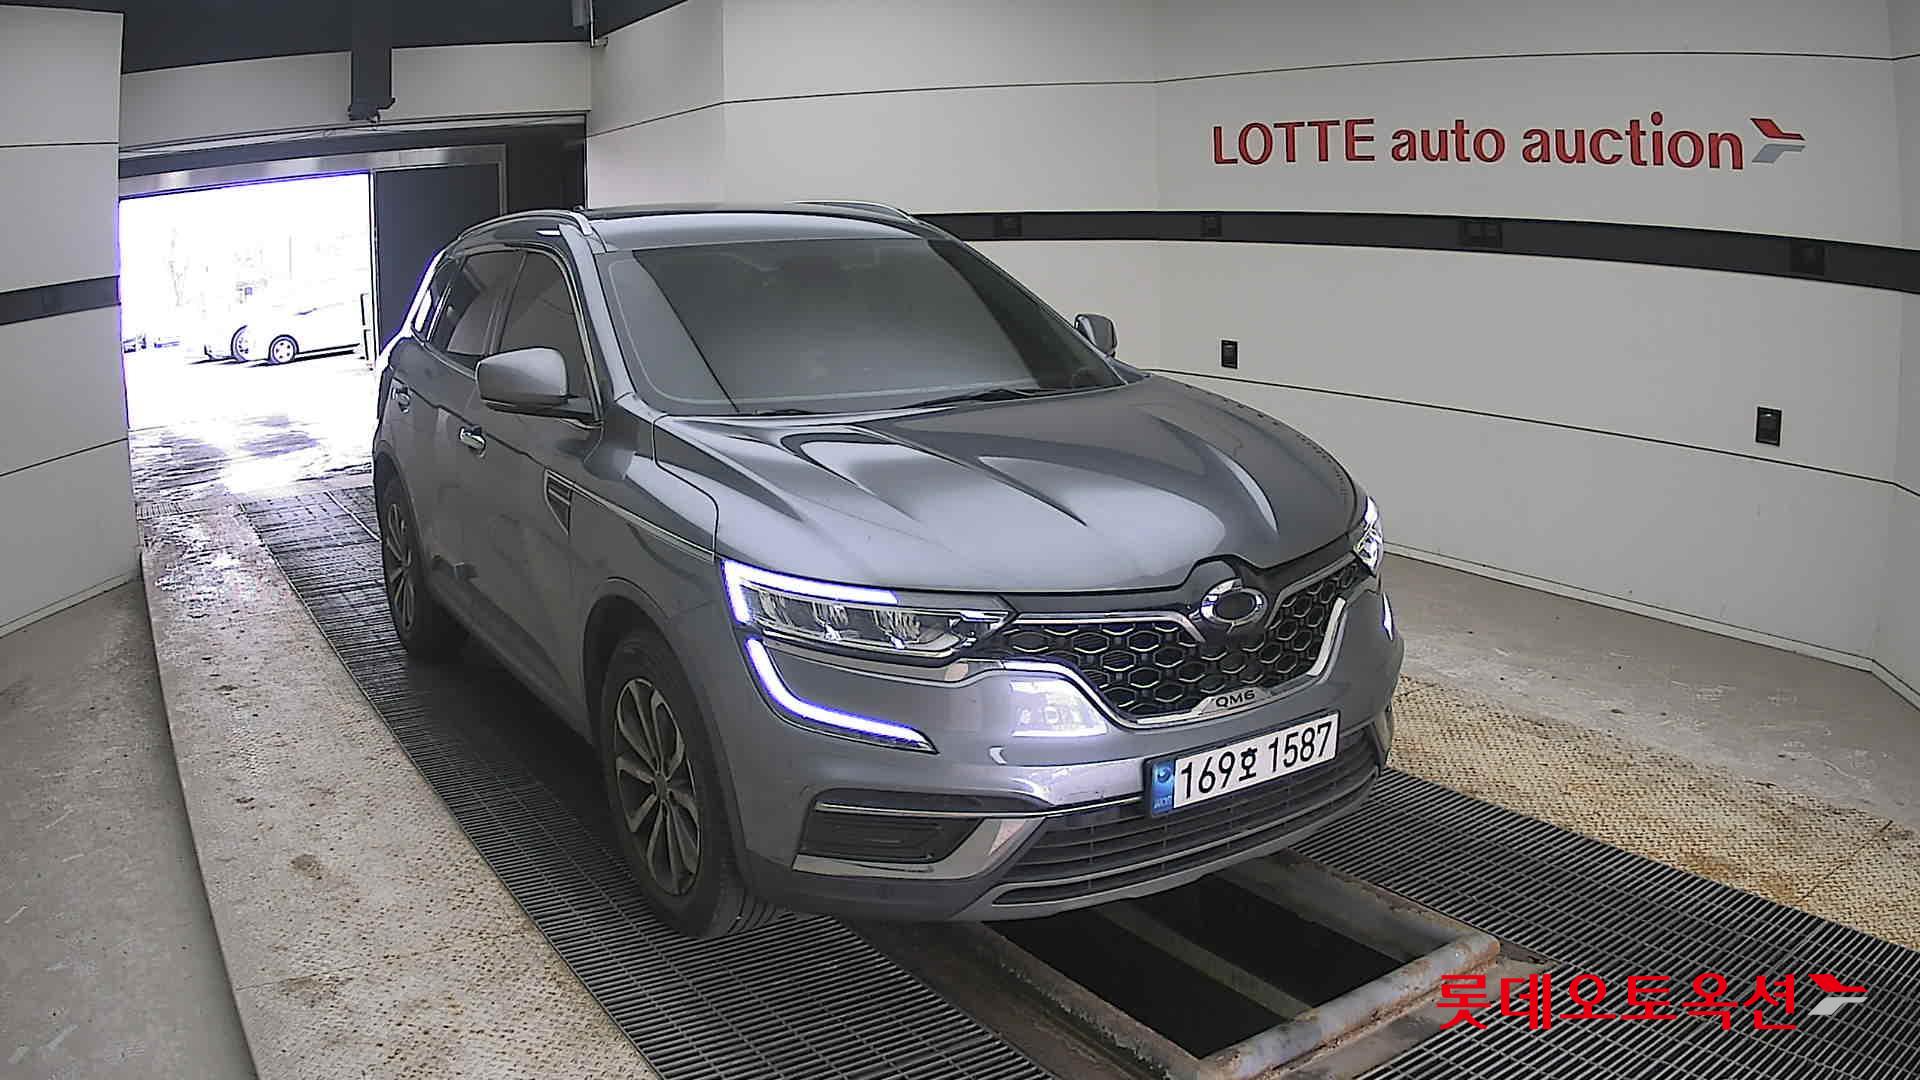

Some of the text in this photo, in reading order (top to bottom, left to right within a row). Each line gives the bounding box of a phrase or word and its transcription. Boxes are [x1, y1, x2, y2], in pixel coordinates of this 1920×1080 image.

[1213, 112, 1744, 170] LOTTE auto auction
[1215, 690, 1256, 708] QM6
[1180, 721, 1332, 799] 169호 1587
